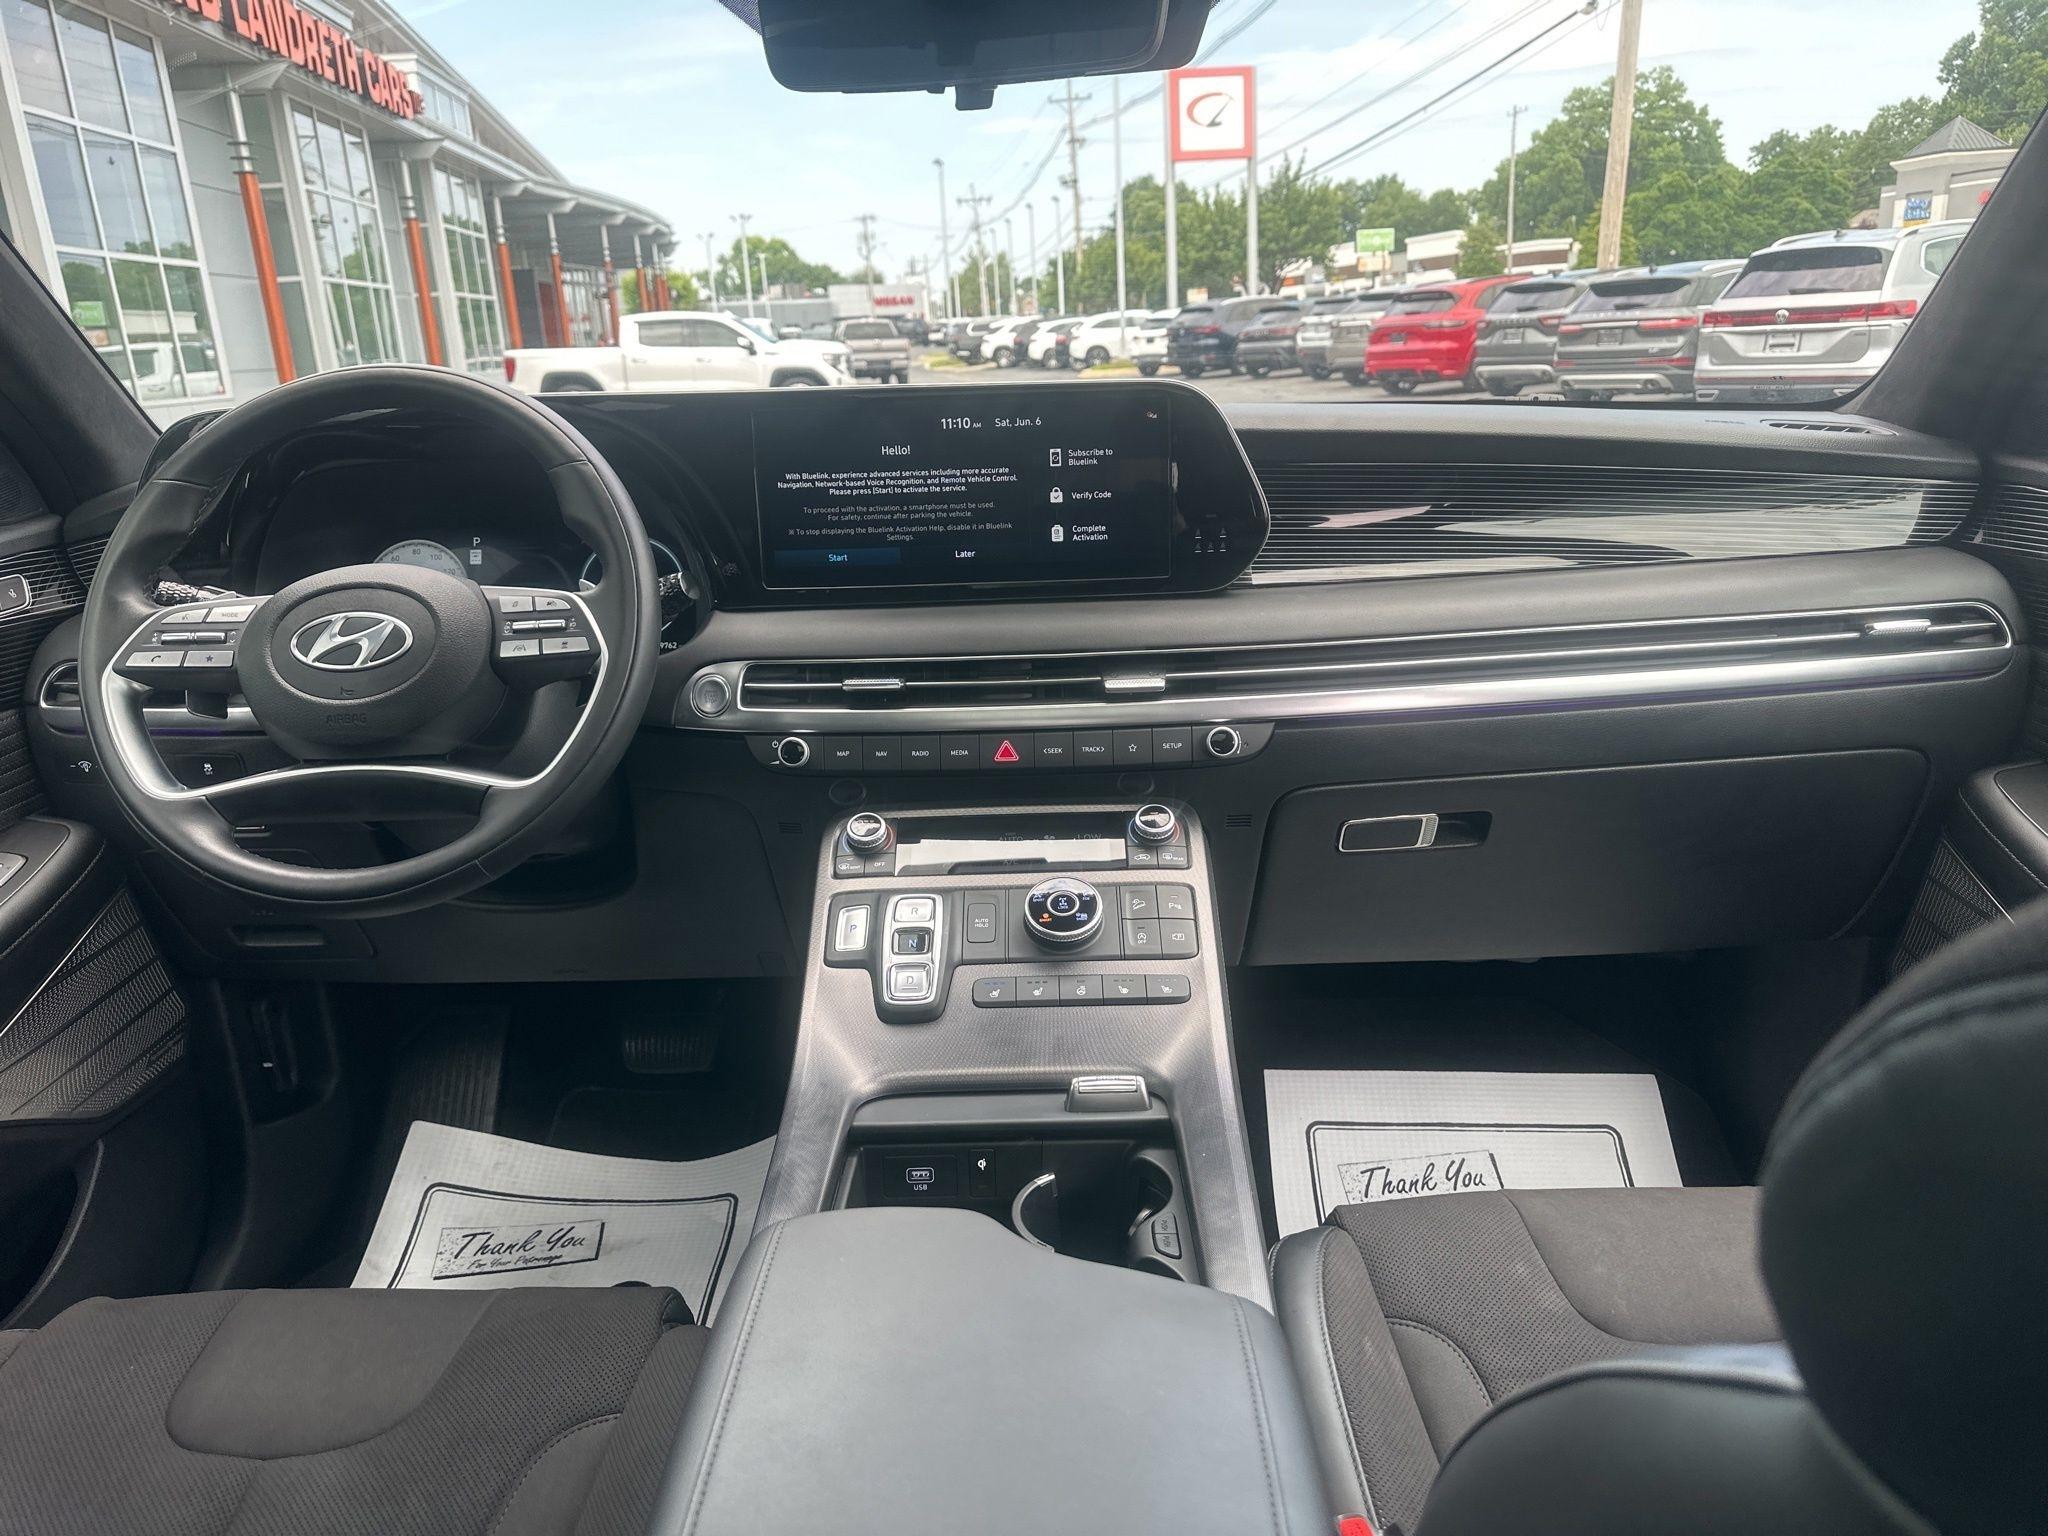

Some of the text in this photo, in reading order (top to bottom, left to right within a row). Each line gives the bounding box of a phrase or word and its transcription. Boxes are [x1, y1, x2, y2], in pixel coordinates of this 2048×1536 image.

[229, 0, 419, 121] LANDRETH CARS
[940, 417, 971, 430] 11:10
[994, 416, 1042, 427] Sat, Jun. 6
[881, 444, 911, 456] Hello!
[1068, 448, 1113, 457] Subscribe to
[1068, 458, 1098, 466] Bluelink
[785, 472, 801, 480] With
[831, 471, 869, 481] experience
[870, 470, 900, 478] advanced
[901, 469, 929, 478] services
[930, 468, 961, 478] including
[961, 468, 979, 476] more
[980, 466, 1010, 475] accurate
[815, 479, 866, 489] Network-based
[866, 479, 885, 487] Voice
[926, 477, 940, 485] and
[940, 476, 966, 485] Remote
[966, 475, 991, 483] Vehicle
[829, 488, 852, 496] Please
[852, 488, 872, 497] press
[895, 486, 902, 494] to
[902, 485, 929, 494] activate
[929, 485, 941, 493] the
[1071, 490, 1112, 500] Verify Code
[803, 506, 812, 514] To
[813, 505, 840, 515] proceed
[841, 505, 856, 513] with
[856, 504, 868, 512] the
[908, 503, 948, 513] smartphone
[949, 502, 967, 510] must
[863, 512, 892, 521] continue
[892, 511, 909, 519] after
[910, 511, 936, 521] parking
[796, 528, 805, 536] To
[805, 527, 820, 536] stop
[821, 526, 855, 537] displaying
[856, 526, 867, 534] the
[867, 525, 895, 534] Bluelink
[895, 525, 928, 533] Activation
[946, 524, 971, 532] disable
[971, 523, 978, 531] it
[978, 523, 985, 531] in
[985, 521, 1014, 530] Bluelink
[1072, 525, 1107, 533] Complete
[473, 537, 481, 547] P
[1072, 533, 1109, 542] Activation
[412, 548, 422, 556] 80
[955, 549, 976, 559] Later
[390, 554, 400, 563] 60
[429, 553, 443, 562] 100
[828, 553, 849, 563] Start
[326, 713, 368, 725] AIRBAG
[950, 749, 969, 757] MEDIA
[911, 907, 919, 916] R
[849, 924, 857, 934] P
[908, 938, 917, 949] N
[906, 975, 914, 985] D
[1359, 1157, 1488, 1199] Thank You
[913, 1184, 928, 1192] USB
[453, 1225, 586, 1260] Thank You
[466, 1258, 488, 1270] For
[490, 1257, 512, 1268] Your
